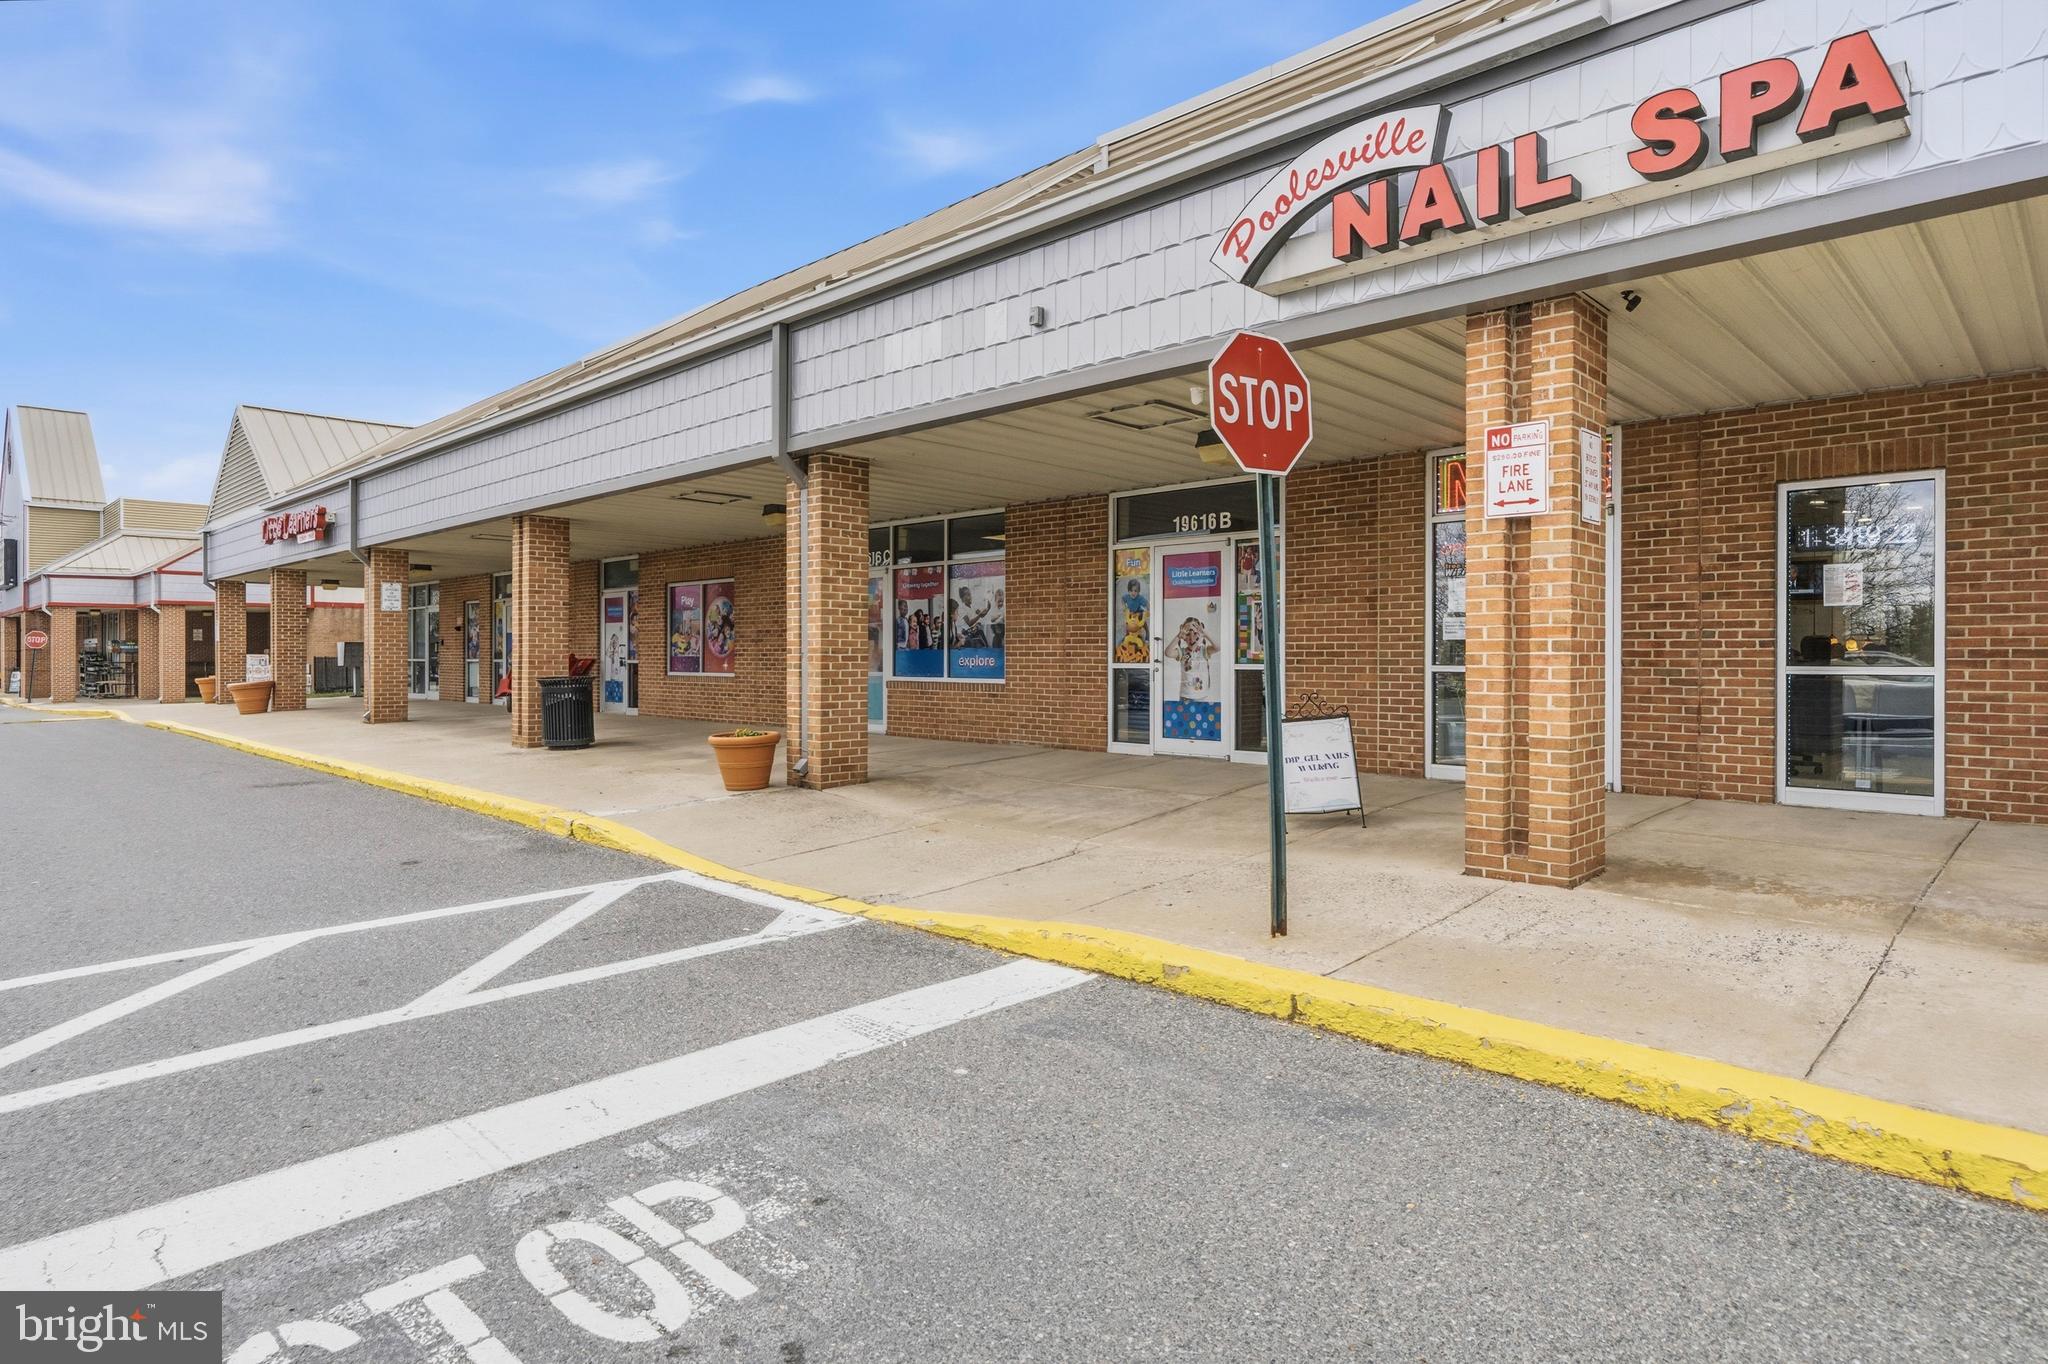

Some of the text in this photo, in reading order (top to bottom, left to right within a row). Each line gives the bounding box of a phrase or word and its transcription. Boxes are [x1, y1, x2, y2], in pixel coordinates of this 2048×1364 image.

[1333, 30, 1907, 260] NAIL SPA
[1222, 117, 1426, 263] Poolesville
[1219, 372, 1304, 431] STOP
[1491, 431, 1543, 447] NO PARKING
[1502, 463, 1529, 478] FIRE
[1499, 479, 1533, 493] LANE
[681, 596, 695, 607] Play
[958, 656, 996, 669] explore
